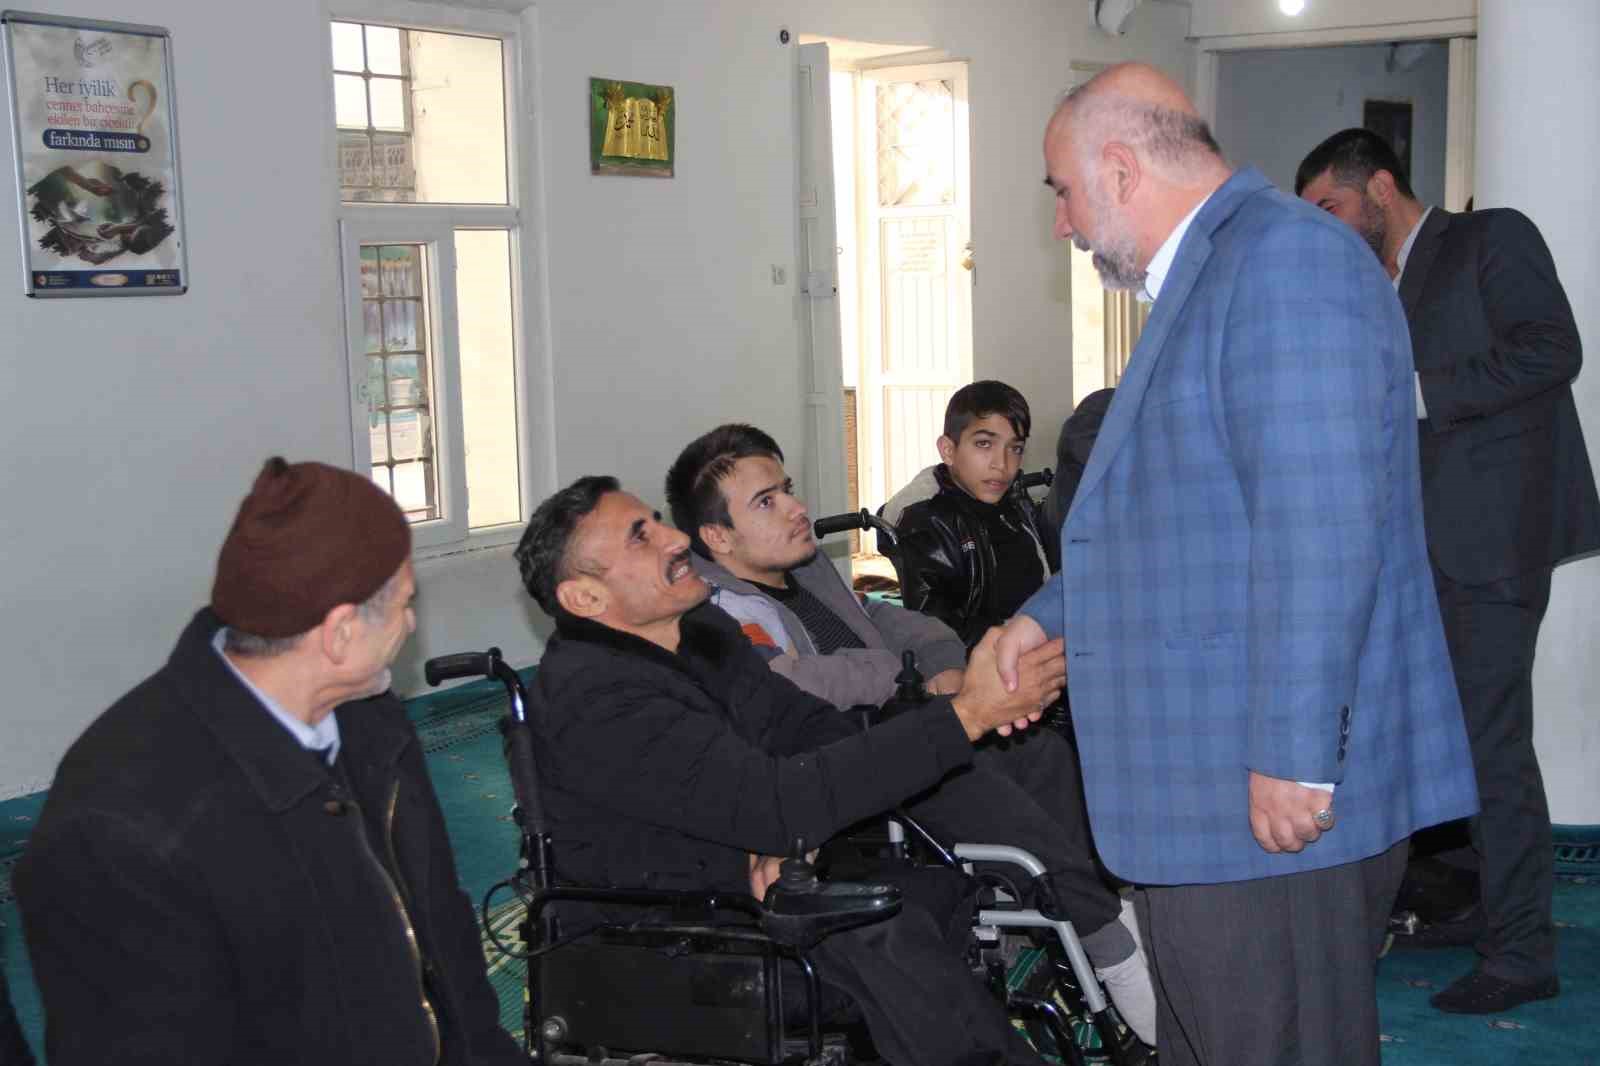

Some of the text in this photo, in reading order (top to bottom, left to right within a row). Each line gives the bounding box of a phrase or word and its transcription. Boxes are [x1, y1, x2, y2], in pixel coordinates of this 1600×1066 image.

[44, 76, 117, 101] Her iyilik
[49, 131, 102, 149] farkında
